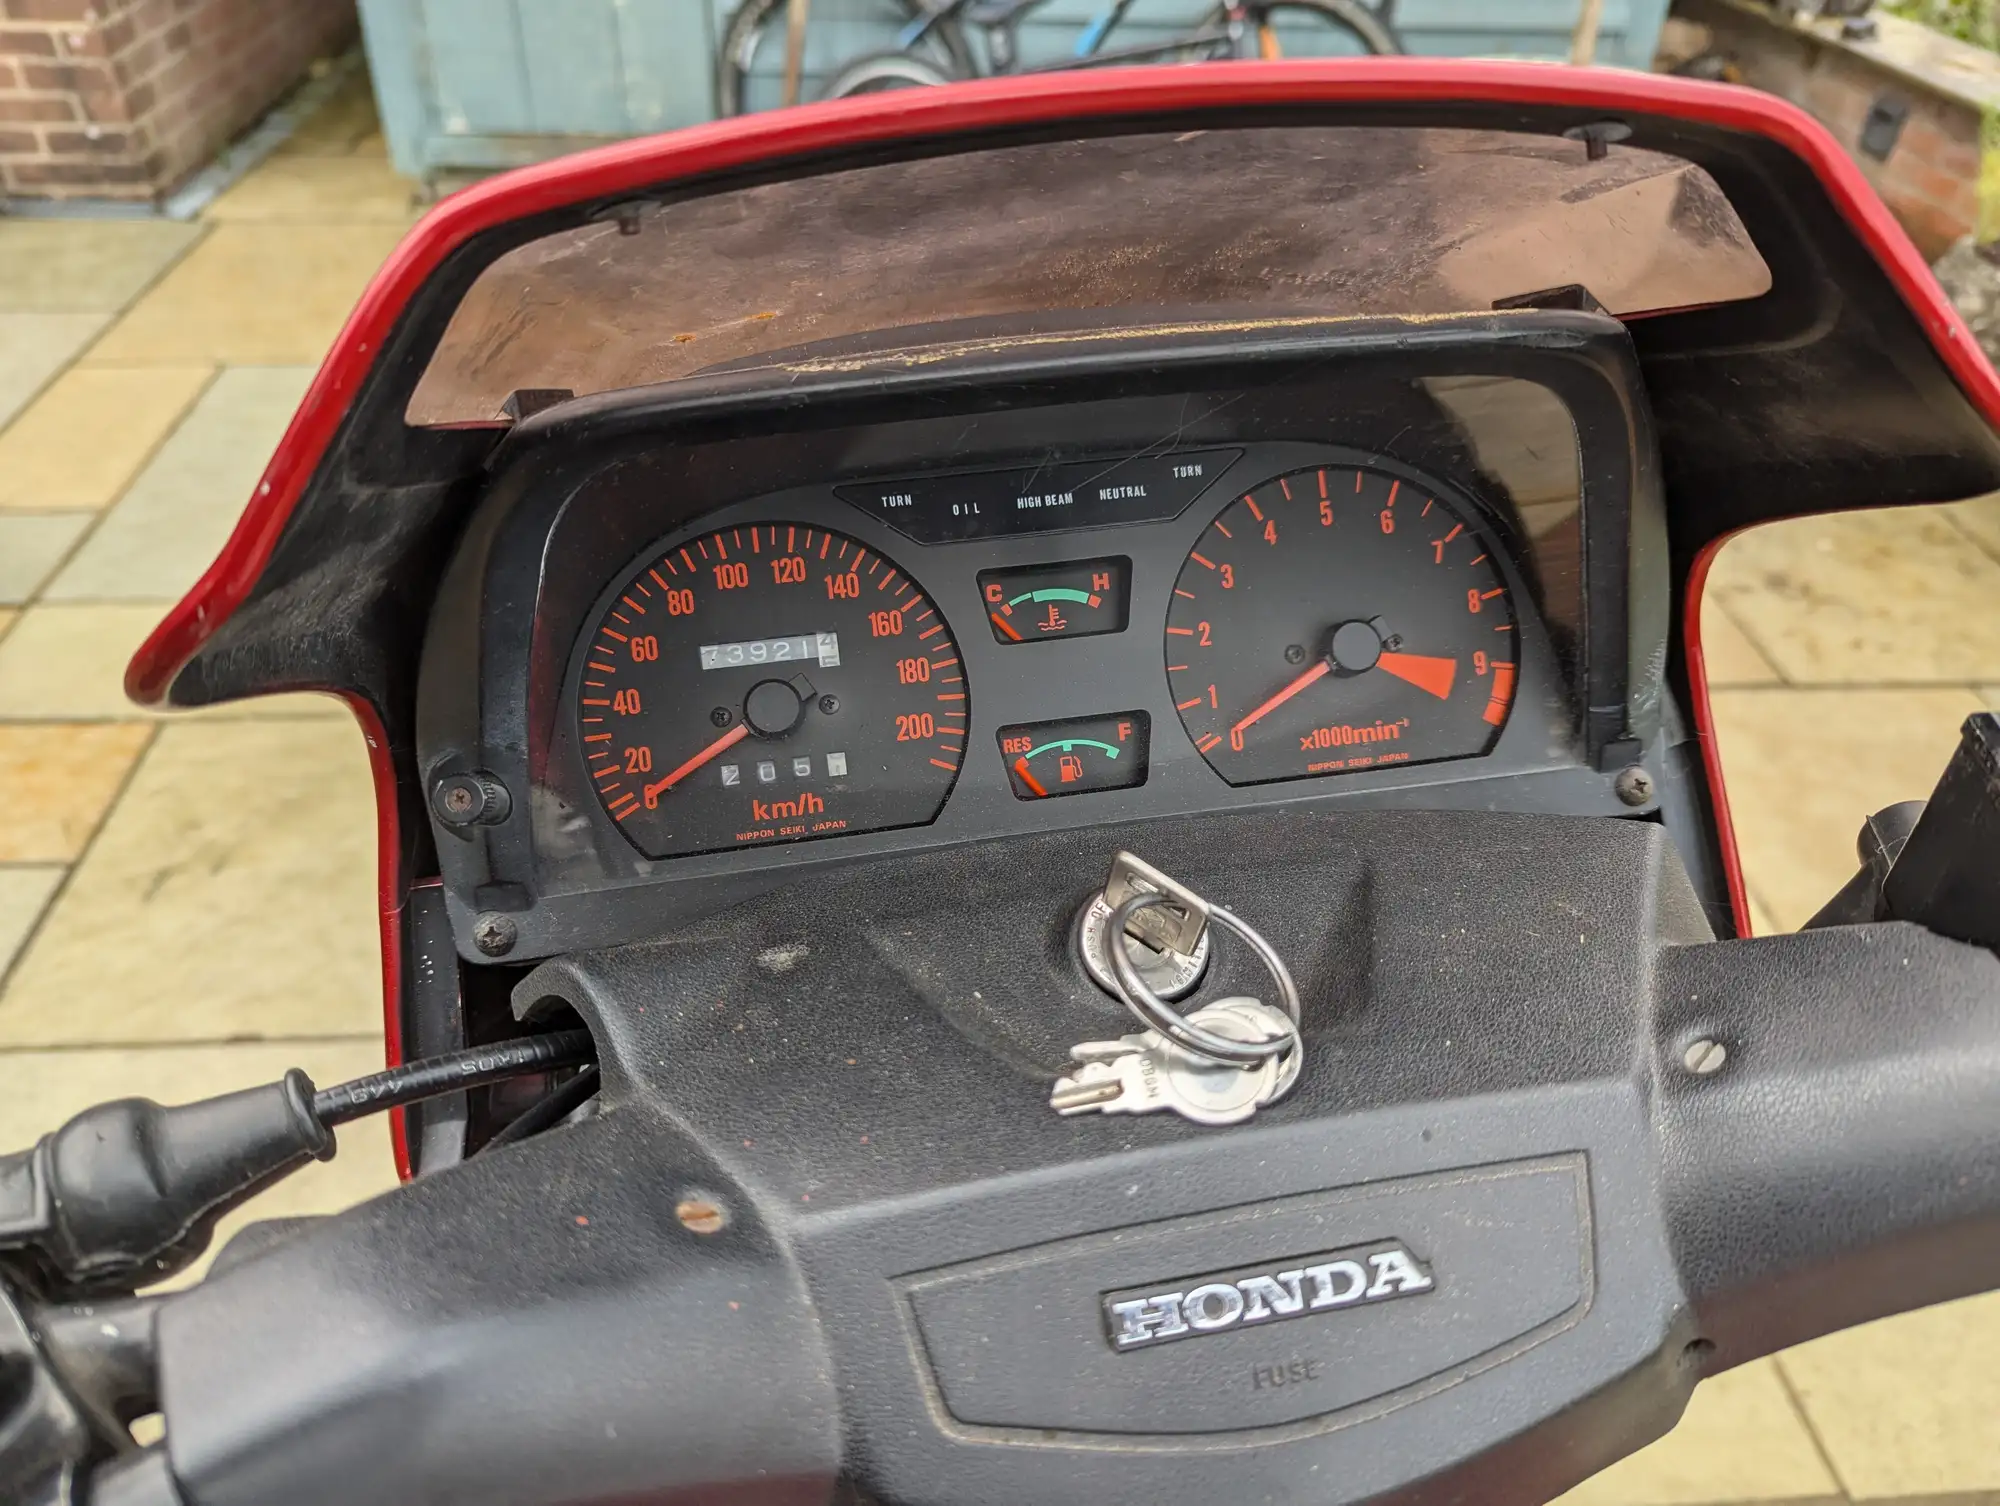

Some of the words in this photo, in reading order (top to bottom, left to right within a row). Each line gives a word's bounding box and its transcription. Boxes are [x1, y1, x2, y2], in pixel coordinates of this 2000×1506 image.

[1173, 465, 1203, 478] TURN
[881, 495, 913, 507] TURN
[1017, 497, 1042, 509] HIGH
[1045, 493, 1073, 507] BEAM
[1100, 485, 1147, 501] NEUTRAL
[1319, 502, 1333, 526] 5
[1380, 510, 1395, 534] 6
[1264, 520, 1277, 545] 4
[1431, 540, 1443, 564] 7
[713, 563, 749, 590] 100
[771, 557, 806, 583] 120
[1092, 573, 1109, 590] H
[1220, 564, 1235, 589] 3
[824, 572, 860, 599] 140
[986, 583, 1002, 603] C
[667, 589, 695, 616] 80
[1467, 589, 1482, 613] 8
[868, 611, 903, 637] 160
[1198, 622, 1212, 647] 2
[631, 635, 659, 662] 60
[896, 657, 930, 684] 180
[1472, 651, 1488, 676] 9
[613, 688, 641, 716] 40
[1207, 684, 1219, 709] 1
[896, 713, 934, 741] 200
[1118, 723, 1131, 741] F
[1230, 728, 1244, 751] 0
[1003, 738, 1032, 755] RES
[624, 745, 652, 774] 20
[1307, 760, 1345, 773] NIPPON
[1348, 757, 1373, 769] SEIKI
[1376, 752, 1410, 764] JAPAN
[753, 793, 824, 821] km/h
[736, 829, 775, 841] NIPPON
[780, 825, 806, 836] SEIKI
[812, 820, 847, 832] JAPAN
[1091, 901, 1107, 920] OF
[1111, 1248, 1432, 1345] HONDA
[1252, 1359, 1321, 1391] FUSE
